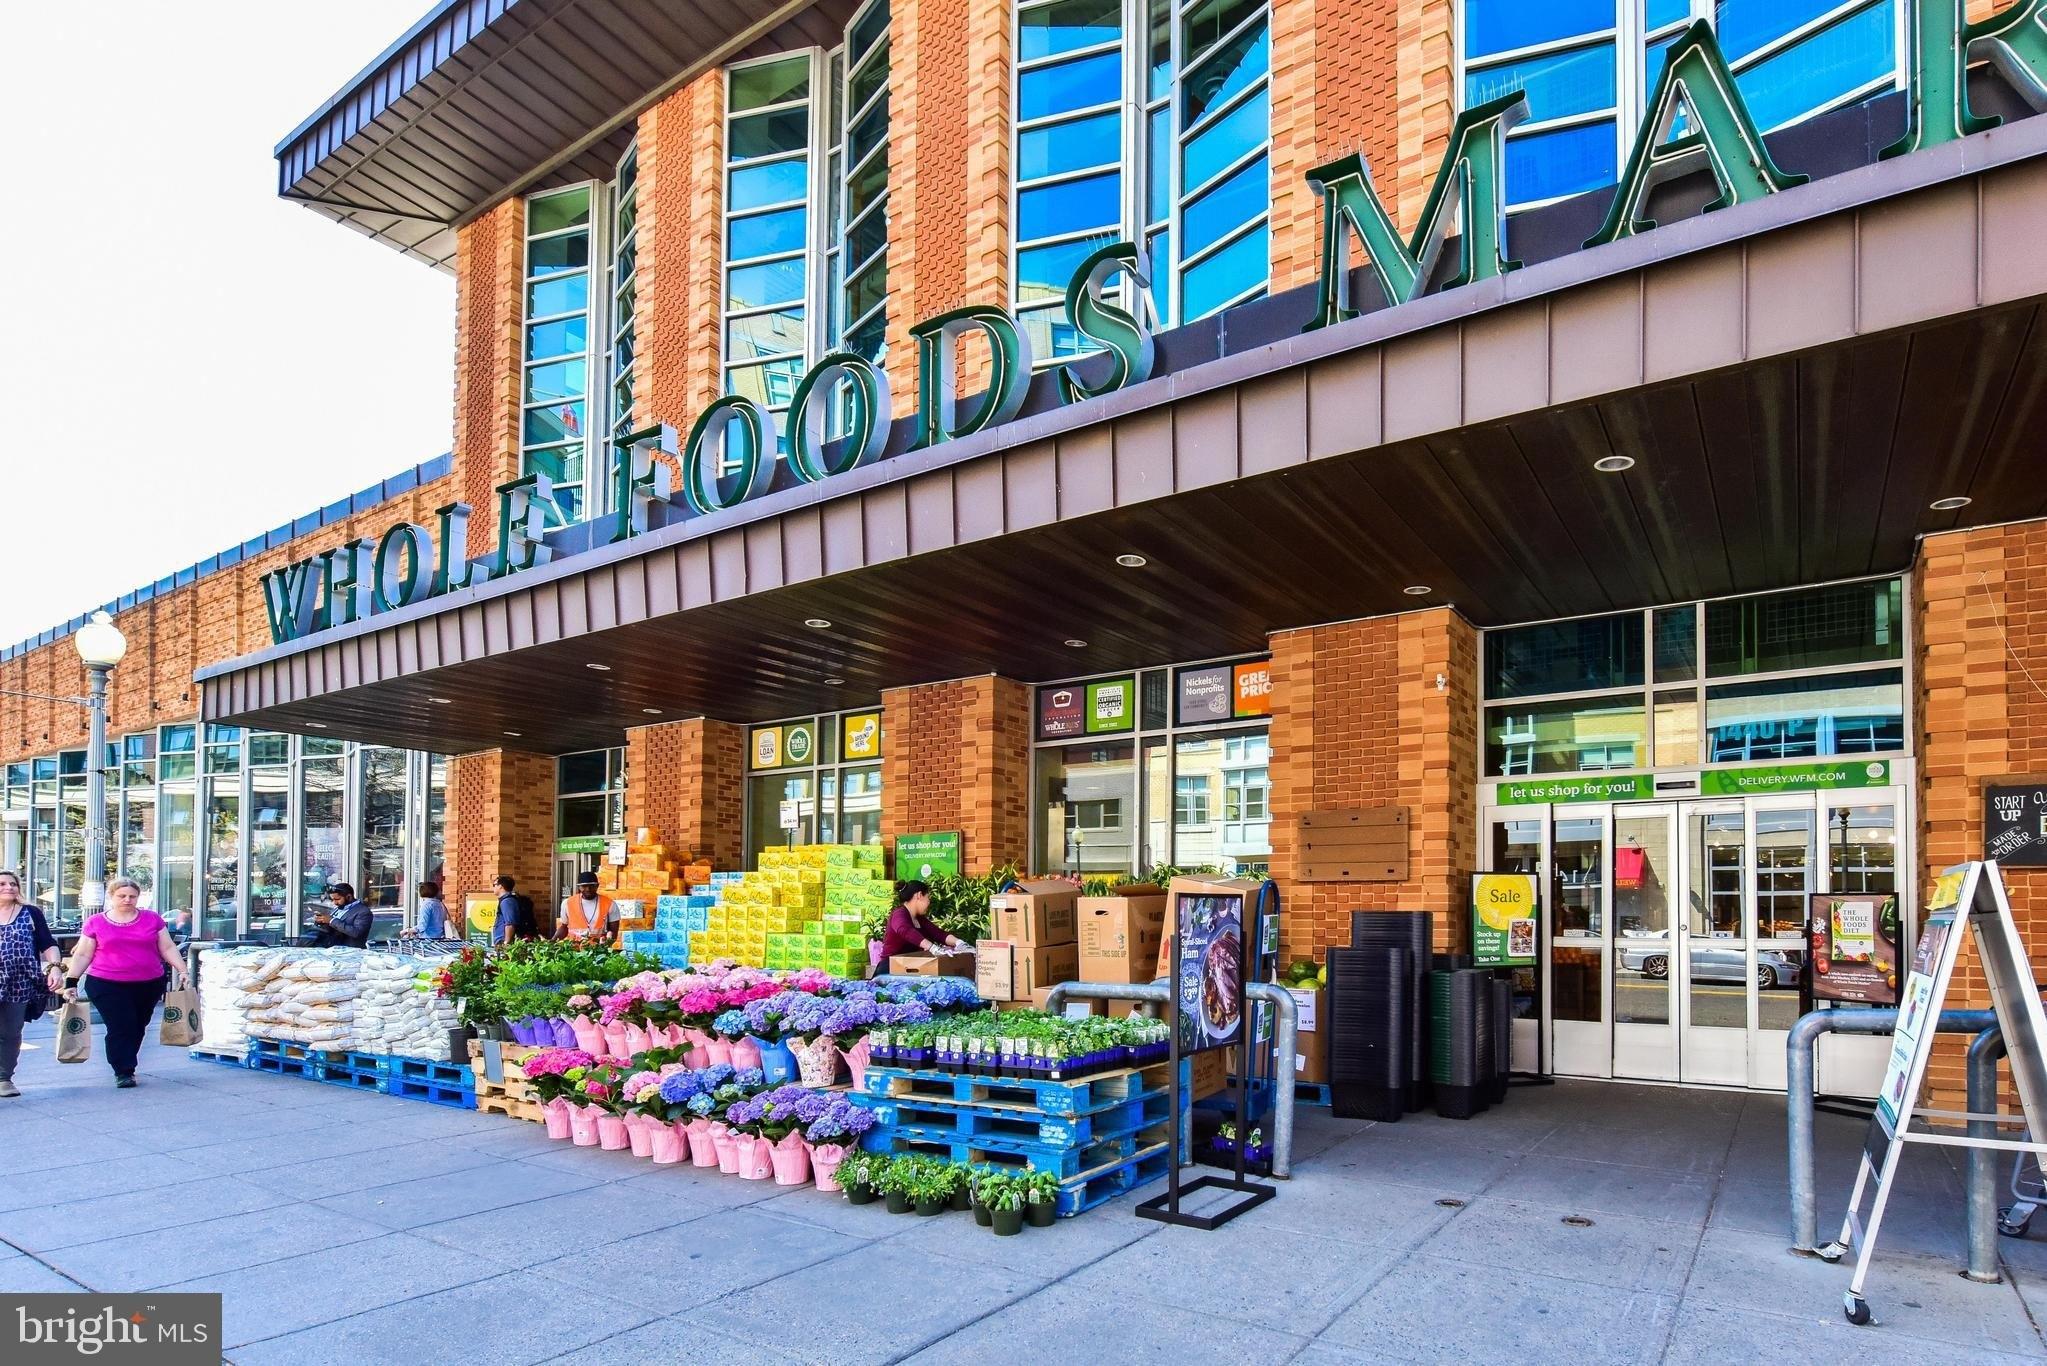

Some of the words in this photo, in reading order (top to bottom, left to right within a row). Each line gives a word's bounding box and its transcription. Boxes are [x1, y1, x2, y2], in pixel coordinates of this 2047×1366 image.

[260, 473, 553, 645] WHOLE
[609, 242, 1156, 543] FOODS
[1186, 676, 1212, 687] Nickels
[1211, 674, 1222, 685] for
[1185, 684, 1225, 696] Nonprofits
[1241, 681, 1274, 698] PRIC
[1719, 720, 1776, 742] 1440
[760, 748, 774, 756] LOAN
[1738, 772, 1846, 786] DELIVERY.WFM.COM
[1510, 787, 1526, 798] let
[1530, 788, 1544, 797] us
[1548, 785, 1580, 798] shop
[1583, 783, 1602, 794] for
[1605, 780, 1635, 796] you!
[1994, 796, 2026, 810] START
[2000, 810, 2021, 822] UP
[898, 842, 906, 850] let
[916, 841, 931, 850] shop
[932, 840, 941, 848] for
[1992, 830, 2017, 847] MADE
[1999, 832, 2032, 854] ORDER
[1490, 889, 1520, 902] Sale
[480, 908, 496, 918] Sal
[1182, 948, 1198, 959] Ham
[1184, 976, 1198, 987] Sale
